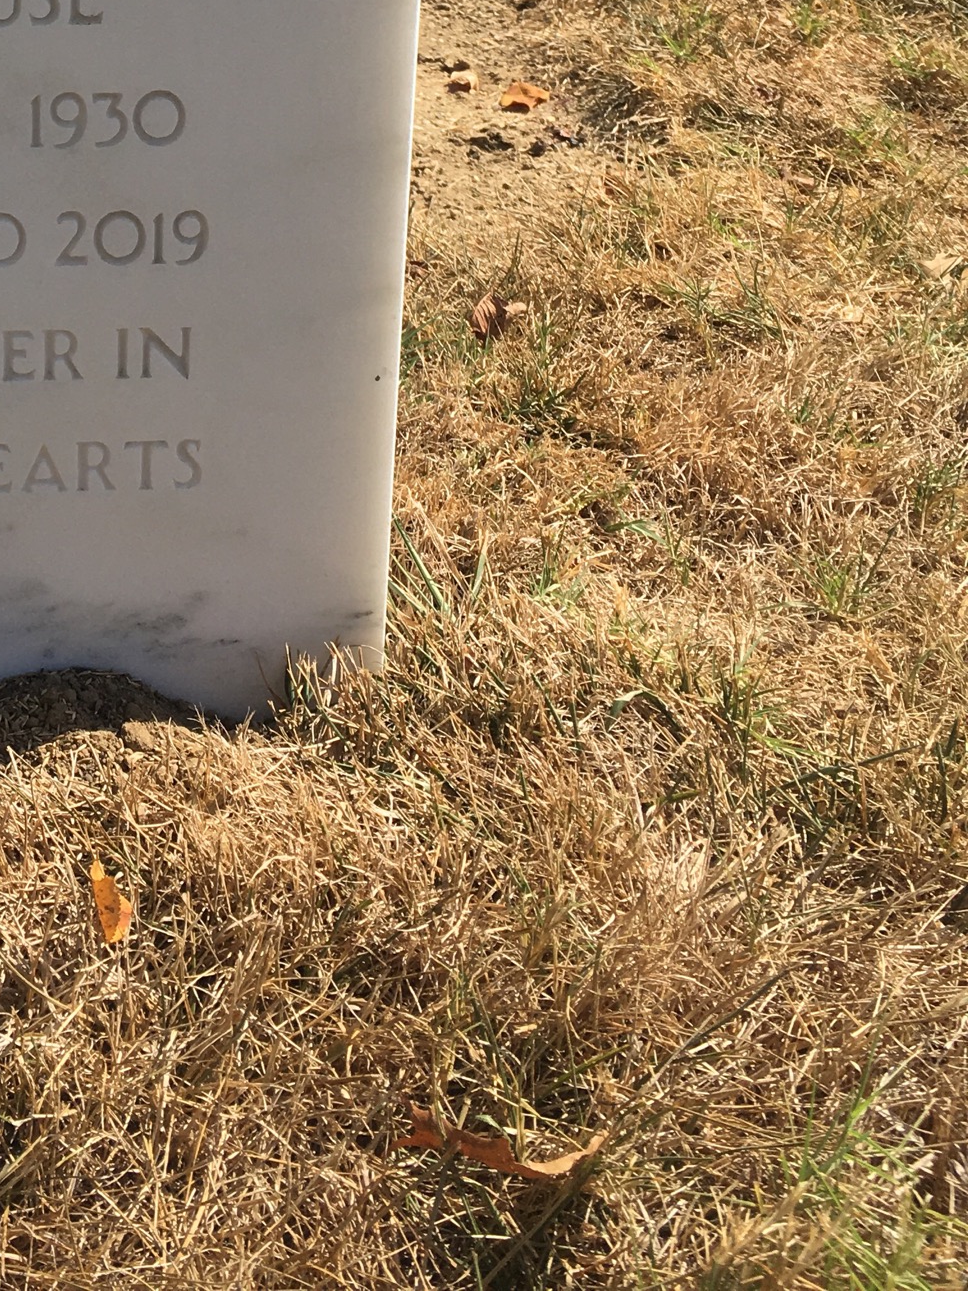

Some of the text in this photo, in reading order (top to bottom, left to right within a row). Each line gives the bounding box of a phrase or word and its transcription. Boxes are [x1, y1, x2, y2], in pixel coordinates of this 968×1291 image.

[30, 89, 187, 148] 1930
[54, 209, 210, 267] 2019
[115, 326, 193, 381] IN
